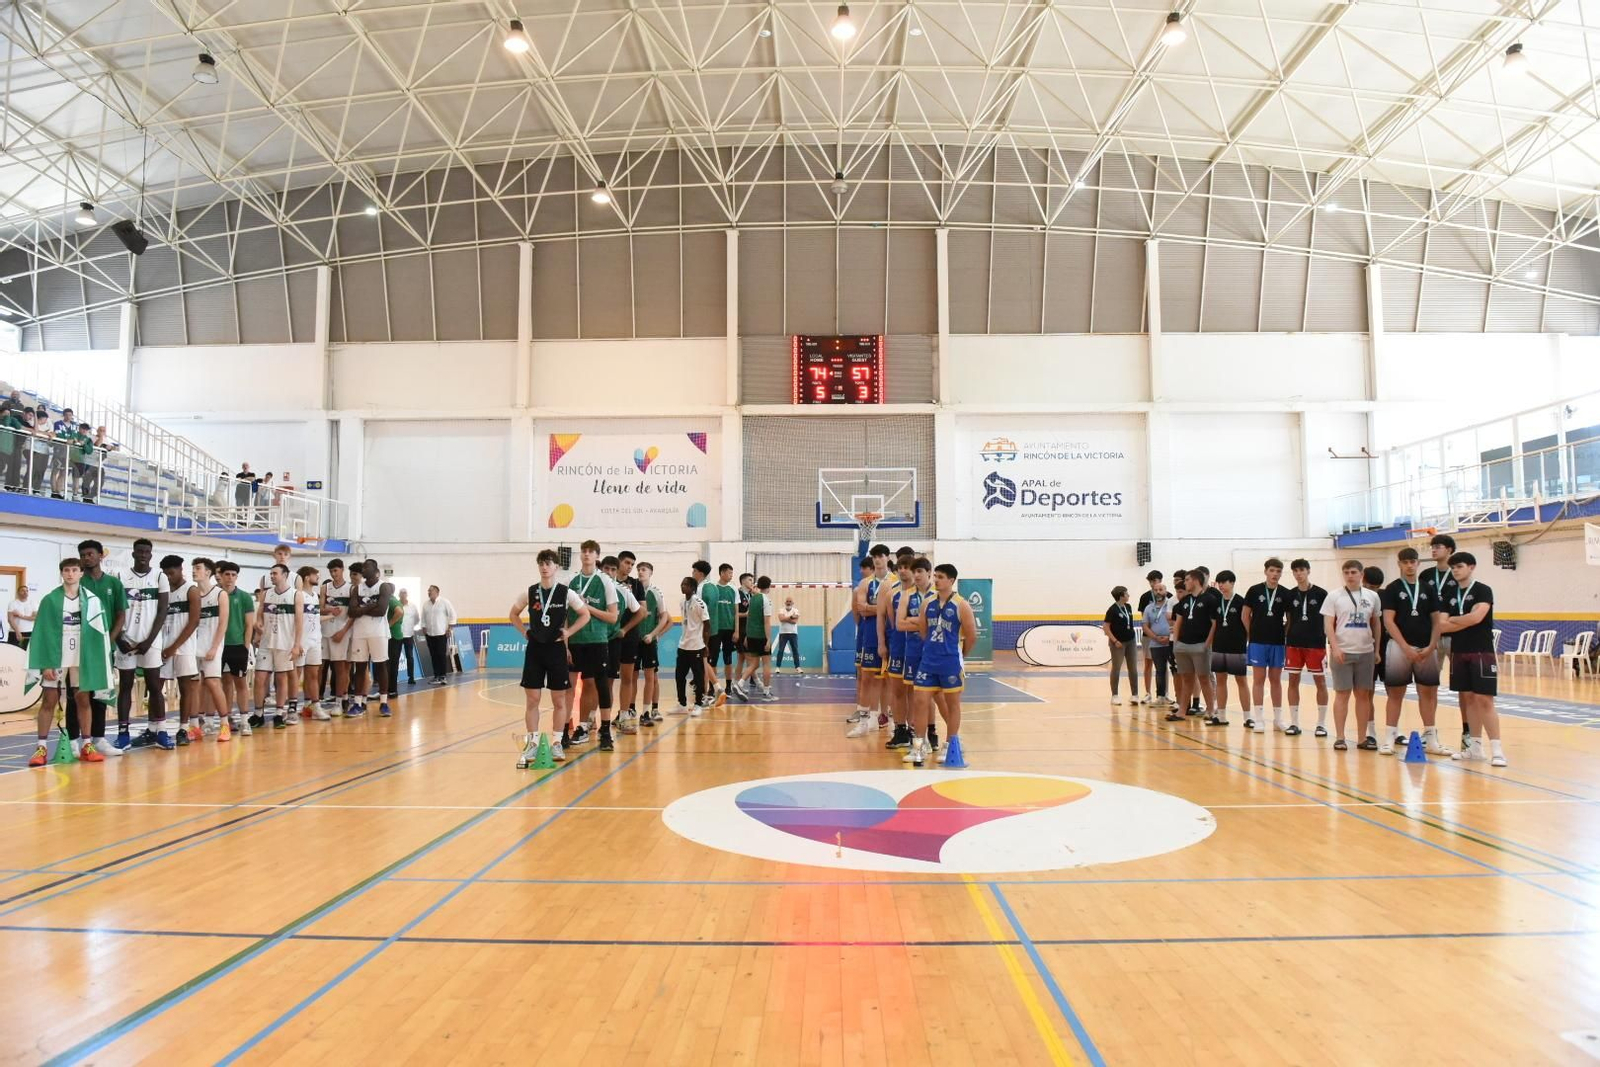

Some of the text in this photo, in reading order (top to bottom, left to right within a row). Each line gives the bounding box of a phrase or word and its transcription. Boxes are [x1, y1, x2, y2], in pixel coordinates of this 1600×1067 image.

[809, 367, 827, 380] 74
[852, 367, 870, 380] 57
[816, 386, 826, 399] 5
[858, 386, 868, 399] 3
[1023, 442, 1089, 450] AYUNTAMIENTO
[1023, 451, 1125, 460] RINCÓN DE LA VICTORIA
[557, 462, 602, 476] RINCÓN
[607, 466, 620, 475] de
[624, 465, 634, 475] la
[635, 480, 651, 493] de
[657, 480, 688, 494] vida
[1021, 479, 1047, 487] APAL
[1021, 489, 1122, 511] Deportes
[930, 631, 944, 643] 24
[69, 637, 76, 651] 9
[497, 641, 519, 652] azul
[891, 659, 901, 668] 12
[907, 666, 913, 674] 1
[916, 671, 928, 681] 24
